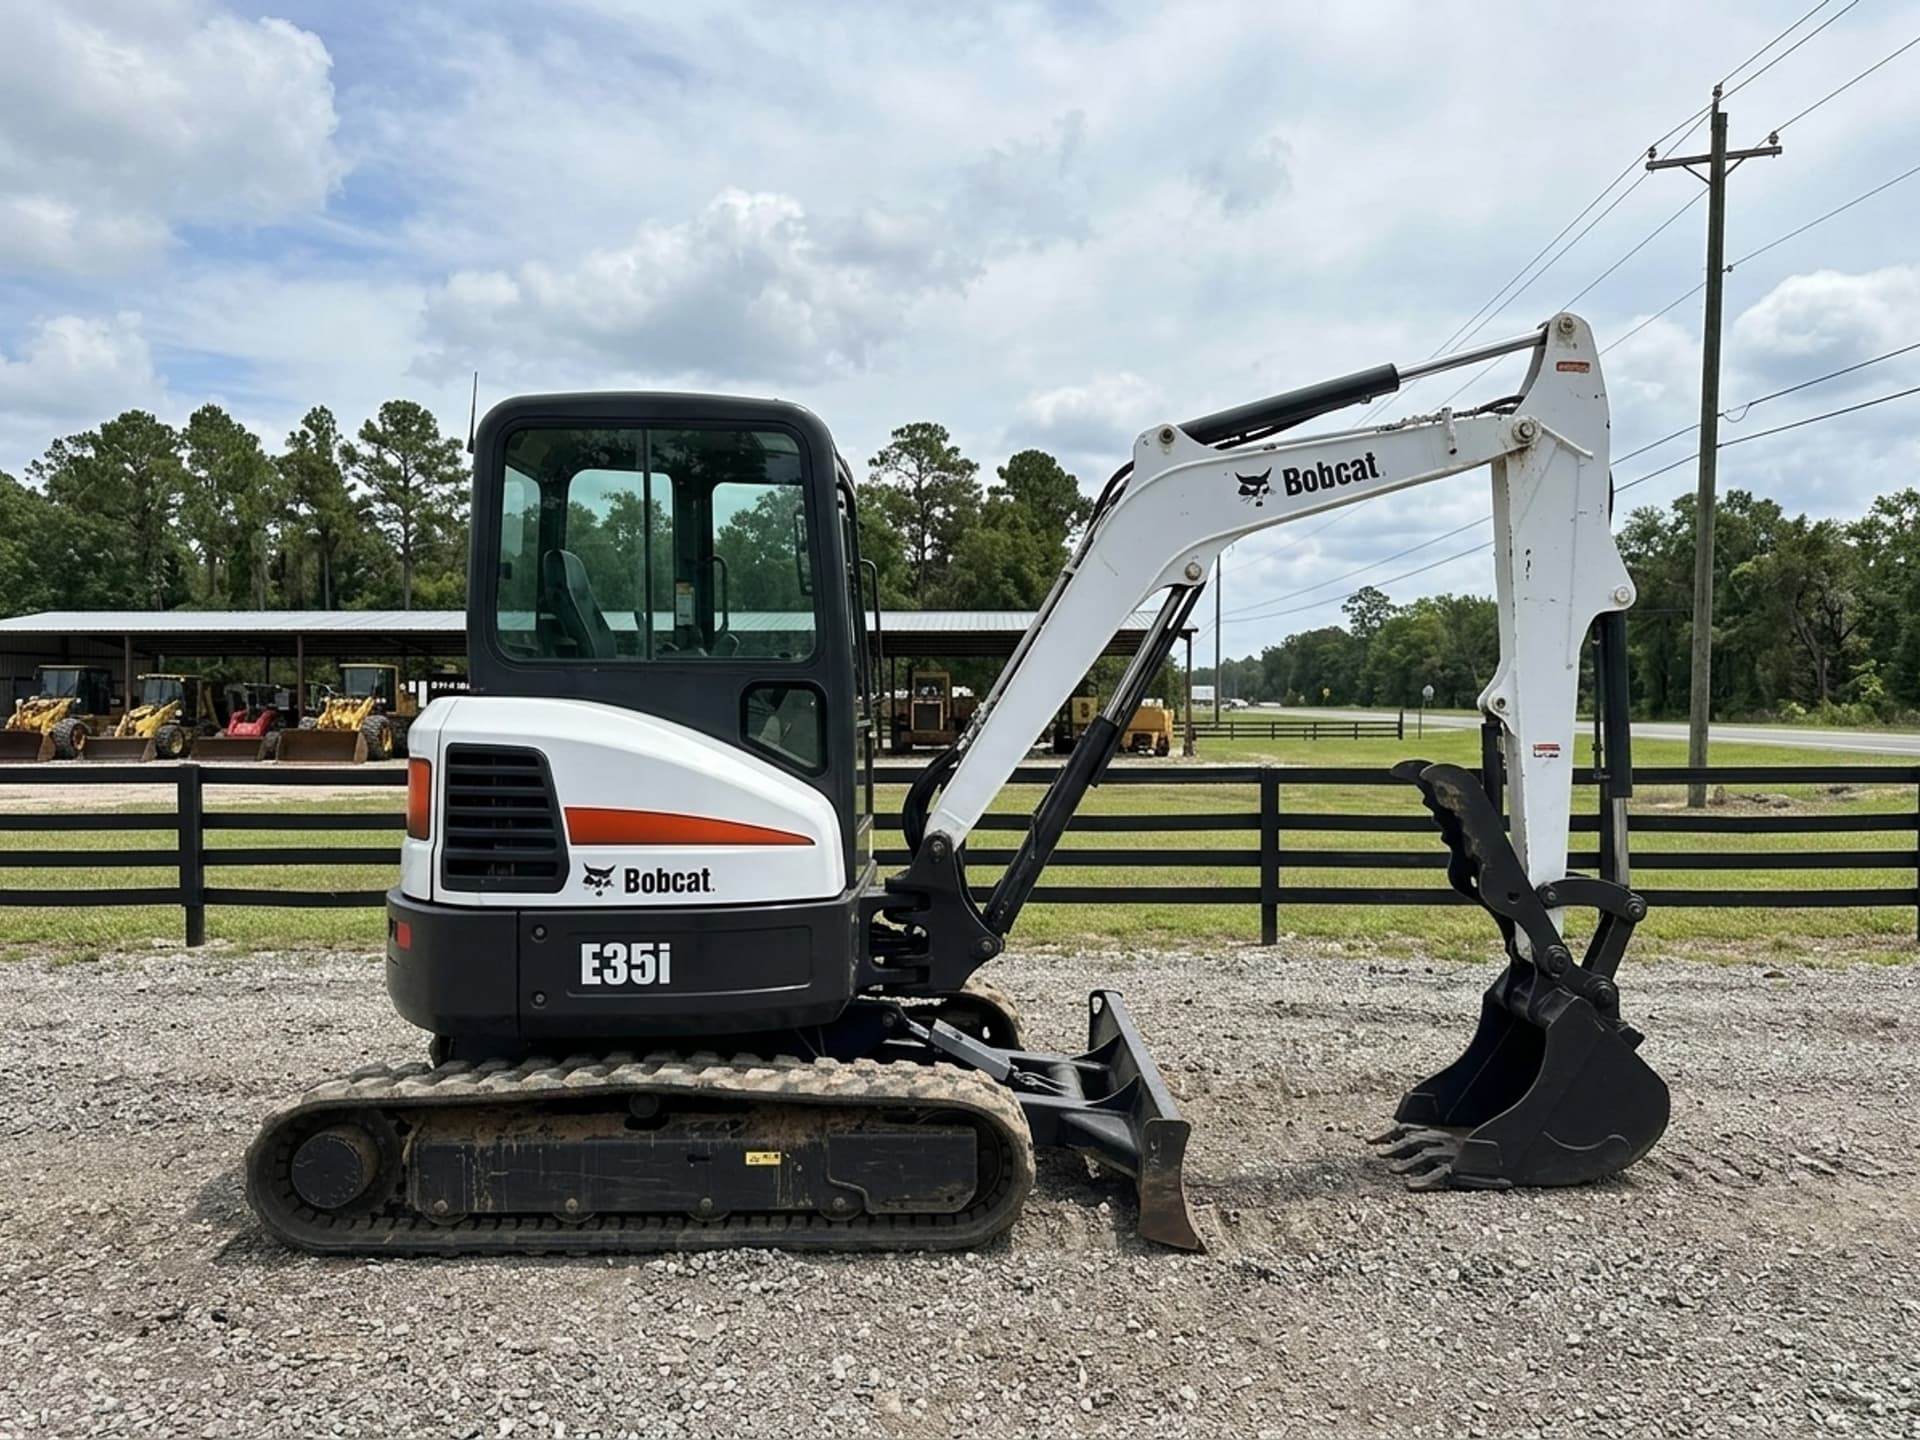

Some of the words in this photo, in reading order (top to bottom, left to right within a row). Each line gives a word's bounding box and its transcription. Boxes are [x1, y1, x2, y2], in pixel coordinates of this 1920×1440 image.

[1282, 452, 1380, 496] Bobcat
[624, 868, 711, 894] Bobcat
[581, 942, 671, 985] E35i
